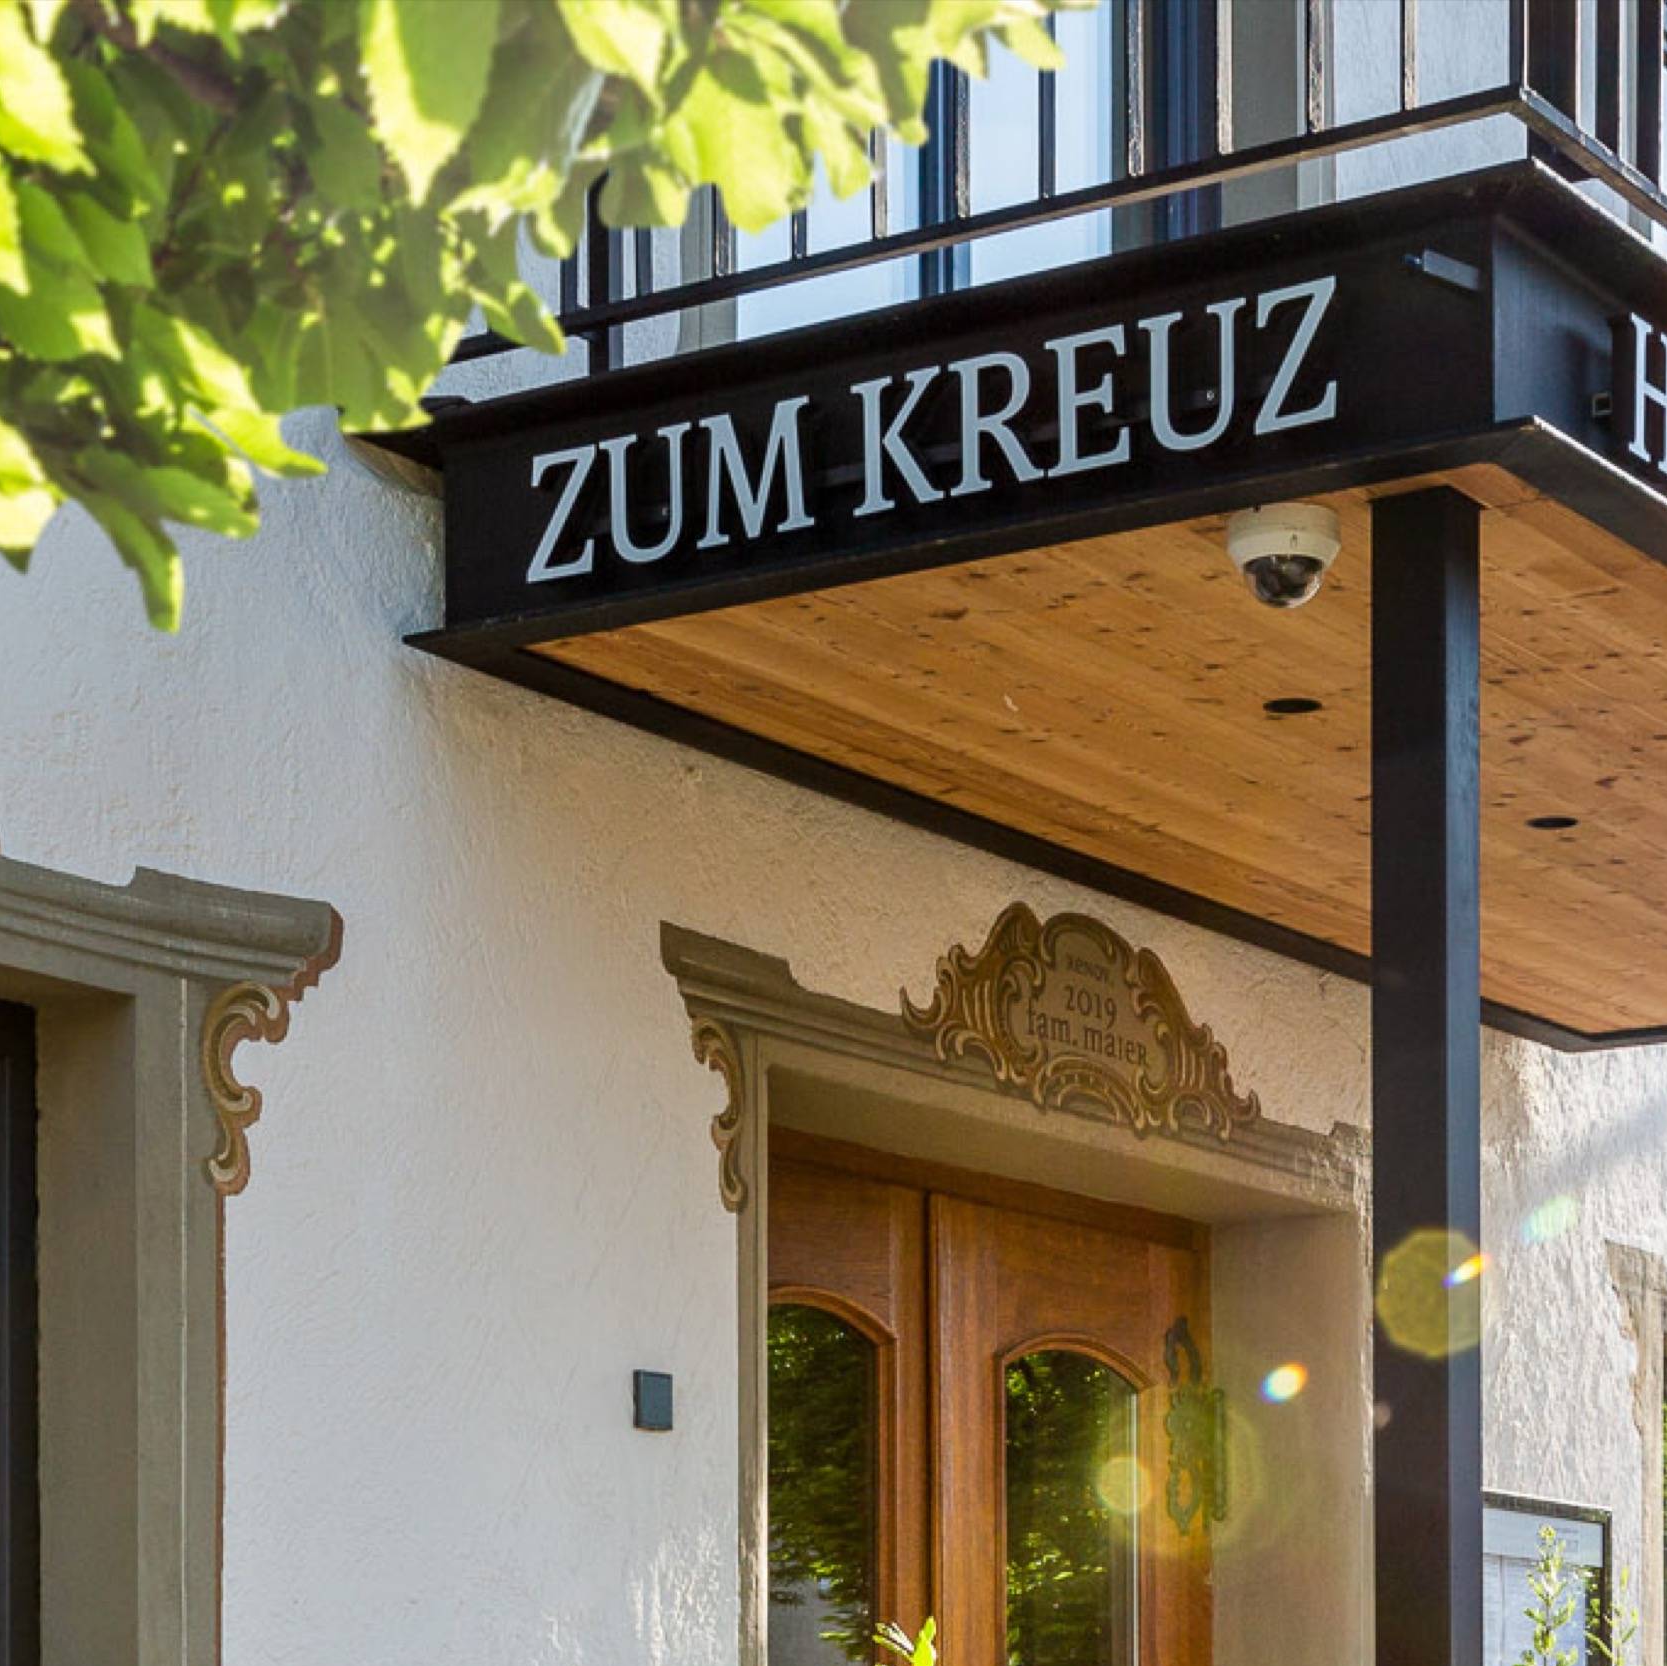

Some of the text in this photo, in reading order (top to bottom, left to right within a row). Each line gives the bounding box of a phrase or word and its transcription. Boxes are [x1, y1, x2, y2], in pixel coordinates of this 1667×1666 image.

[526, 275, 1337, 584] ZUM KREUZ
[1064, 983, 1118, 1030] 2019
